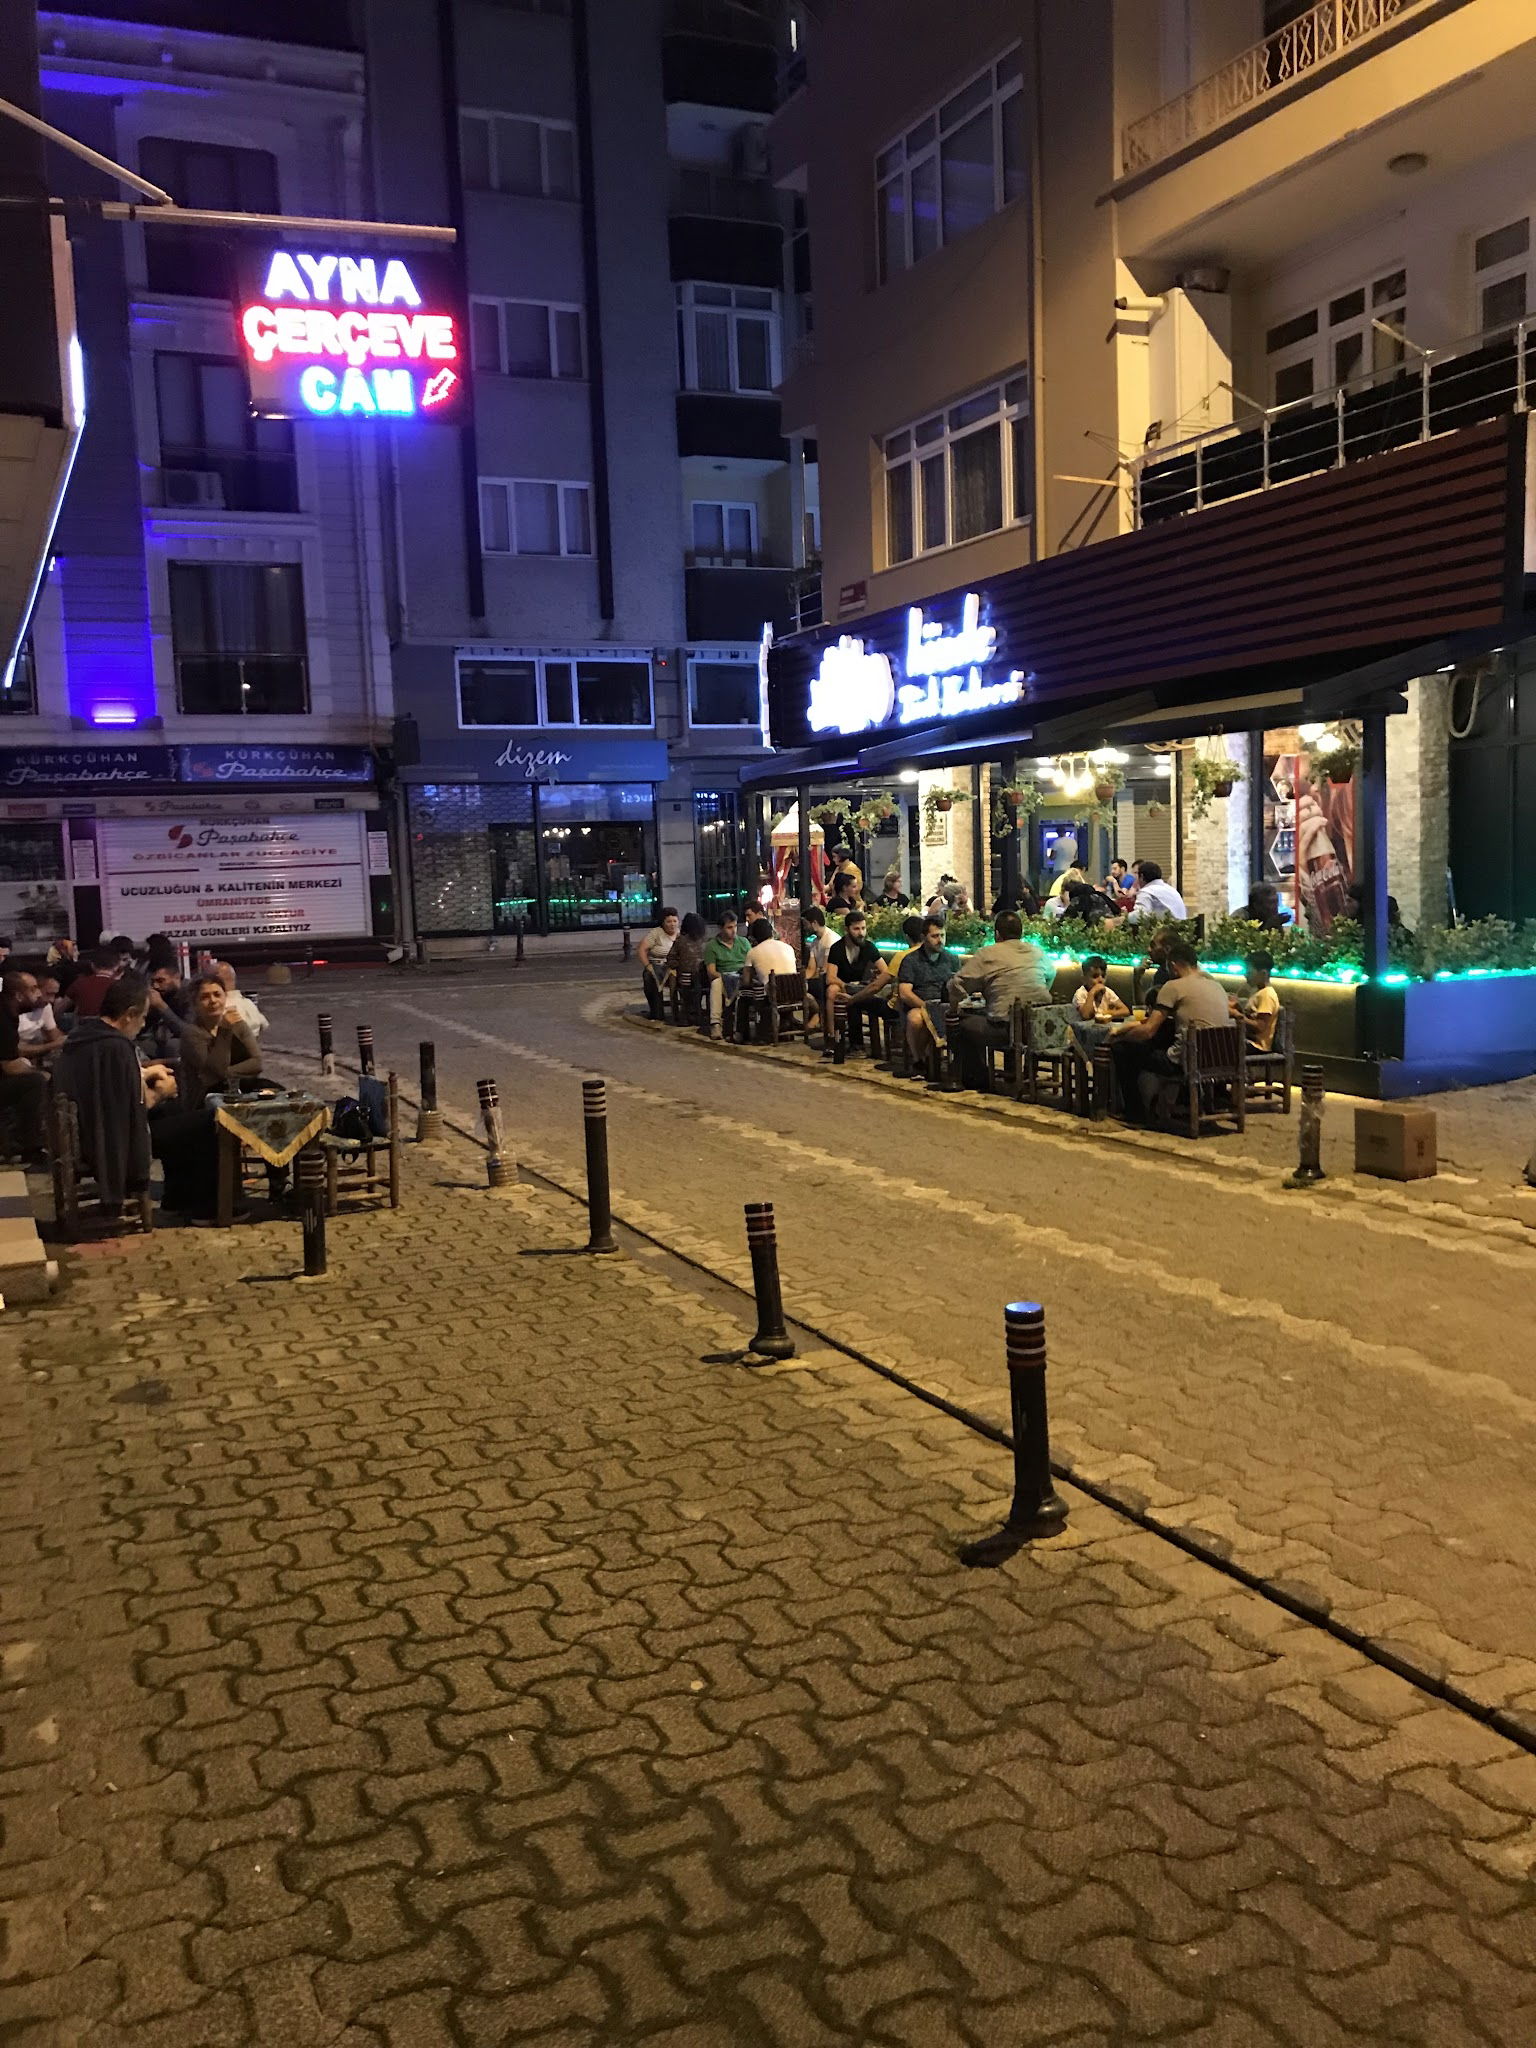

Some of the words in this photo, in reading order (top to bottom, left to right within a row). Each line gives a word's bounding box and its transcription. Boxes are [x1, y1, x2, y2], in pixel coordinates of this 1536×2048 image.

[264, 251, 422, 306] AYNA
[242, 305, 457, 366] ÇERÇEVE
[300, 365, 415, 416] CAM
[494, 739, 573, 777] dizem
[205, 884, 214, 893] &
